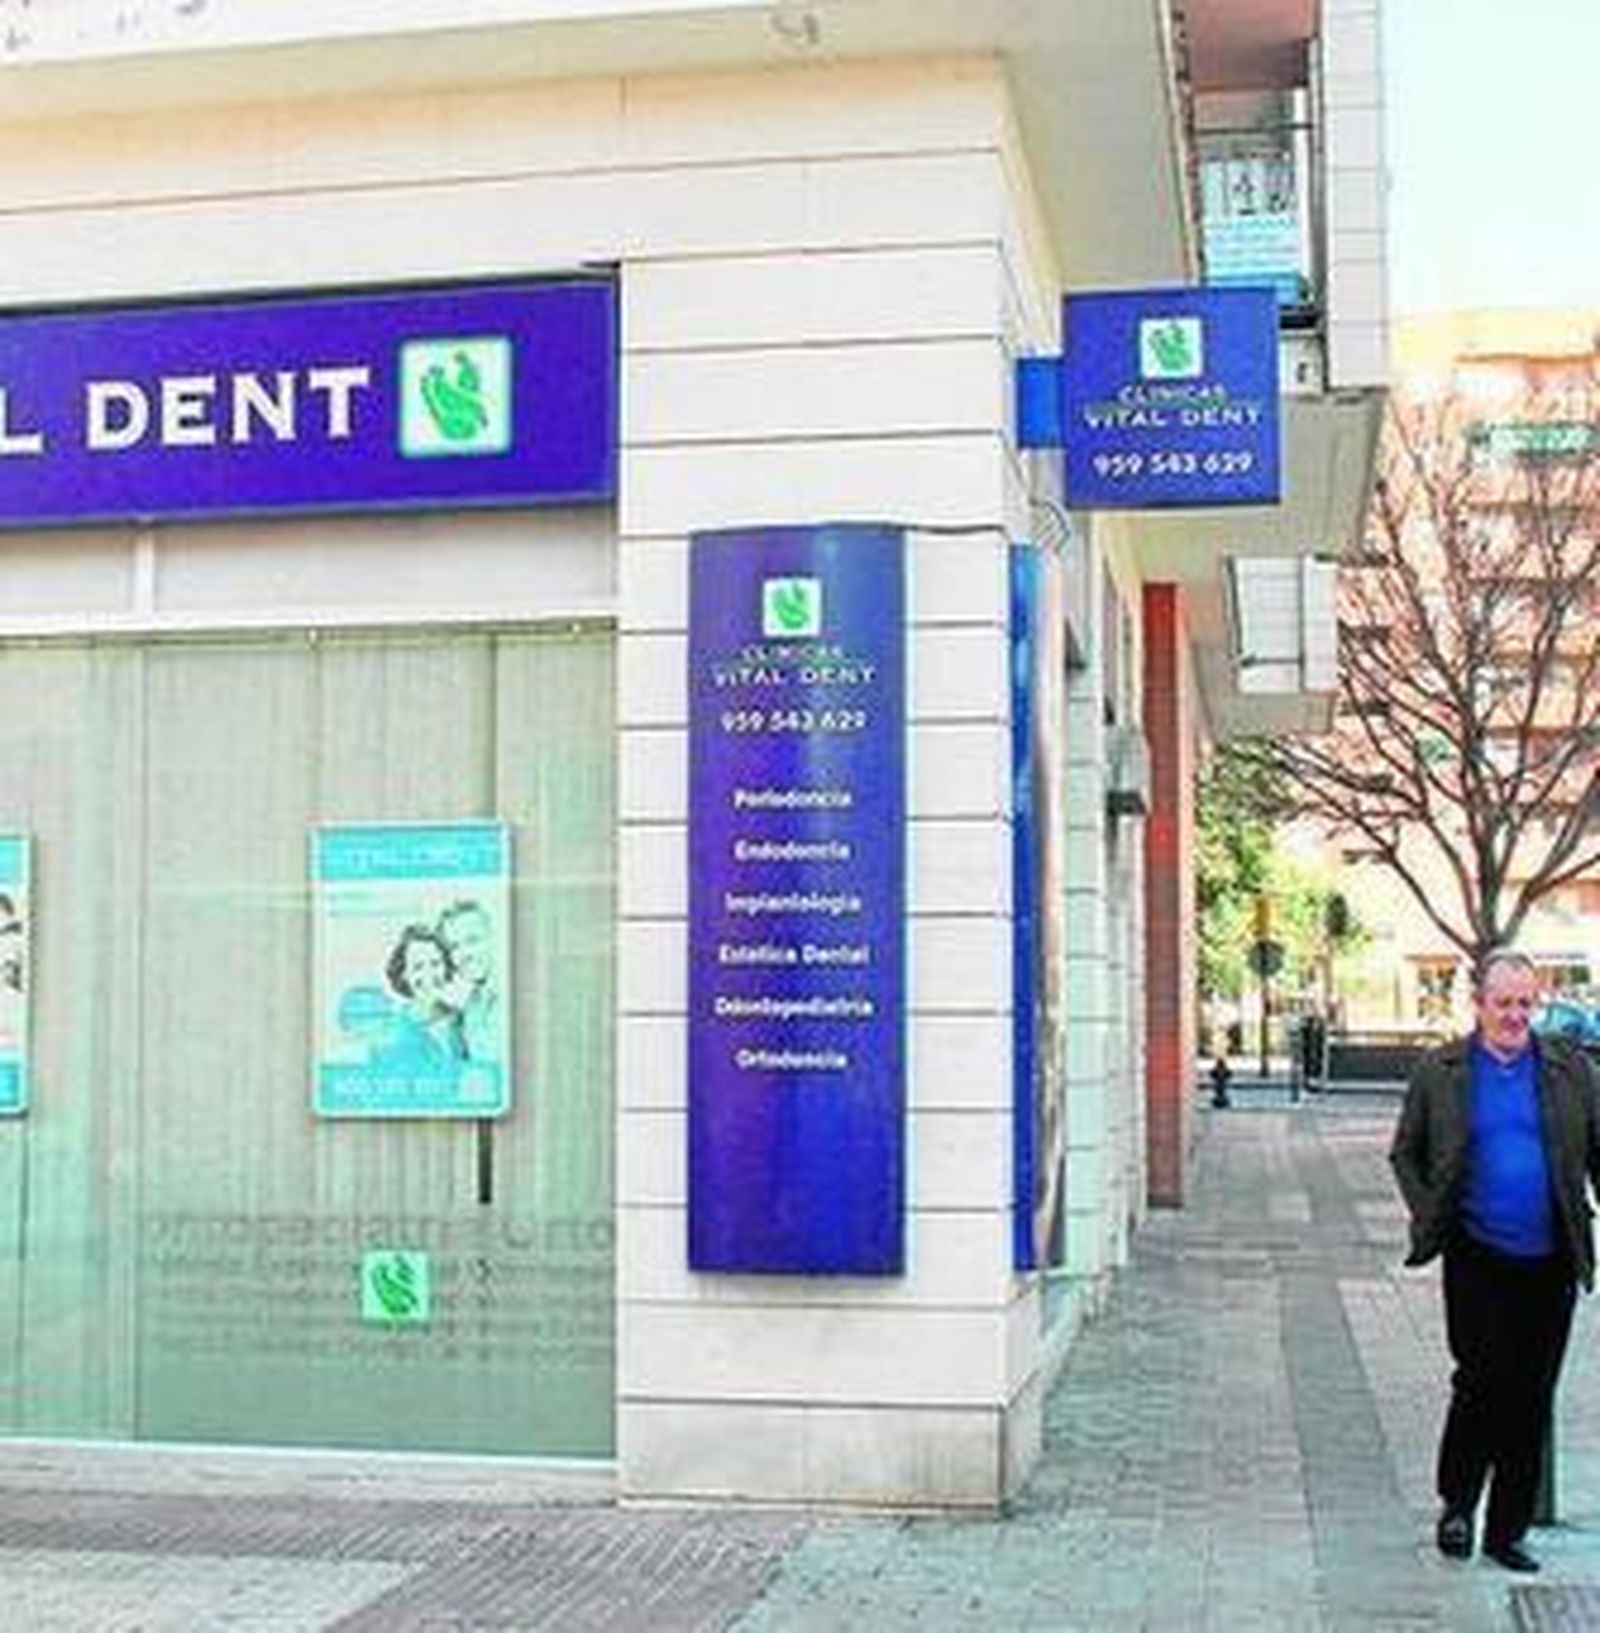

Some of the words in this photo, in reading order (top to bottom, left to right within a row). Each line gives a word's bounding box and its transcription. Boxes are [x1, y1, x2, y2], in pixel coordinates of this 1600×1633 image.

[85, 365, 370, 450] DENT
[1083, 407, 1169, 427] VITAL
[1180, 406, 1260, 427] DENT
[1092, 453, 1144, 477] 959
[801, 666, 876, 685] DENT
[720, 710, 764, 733] 959
